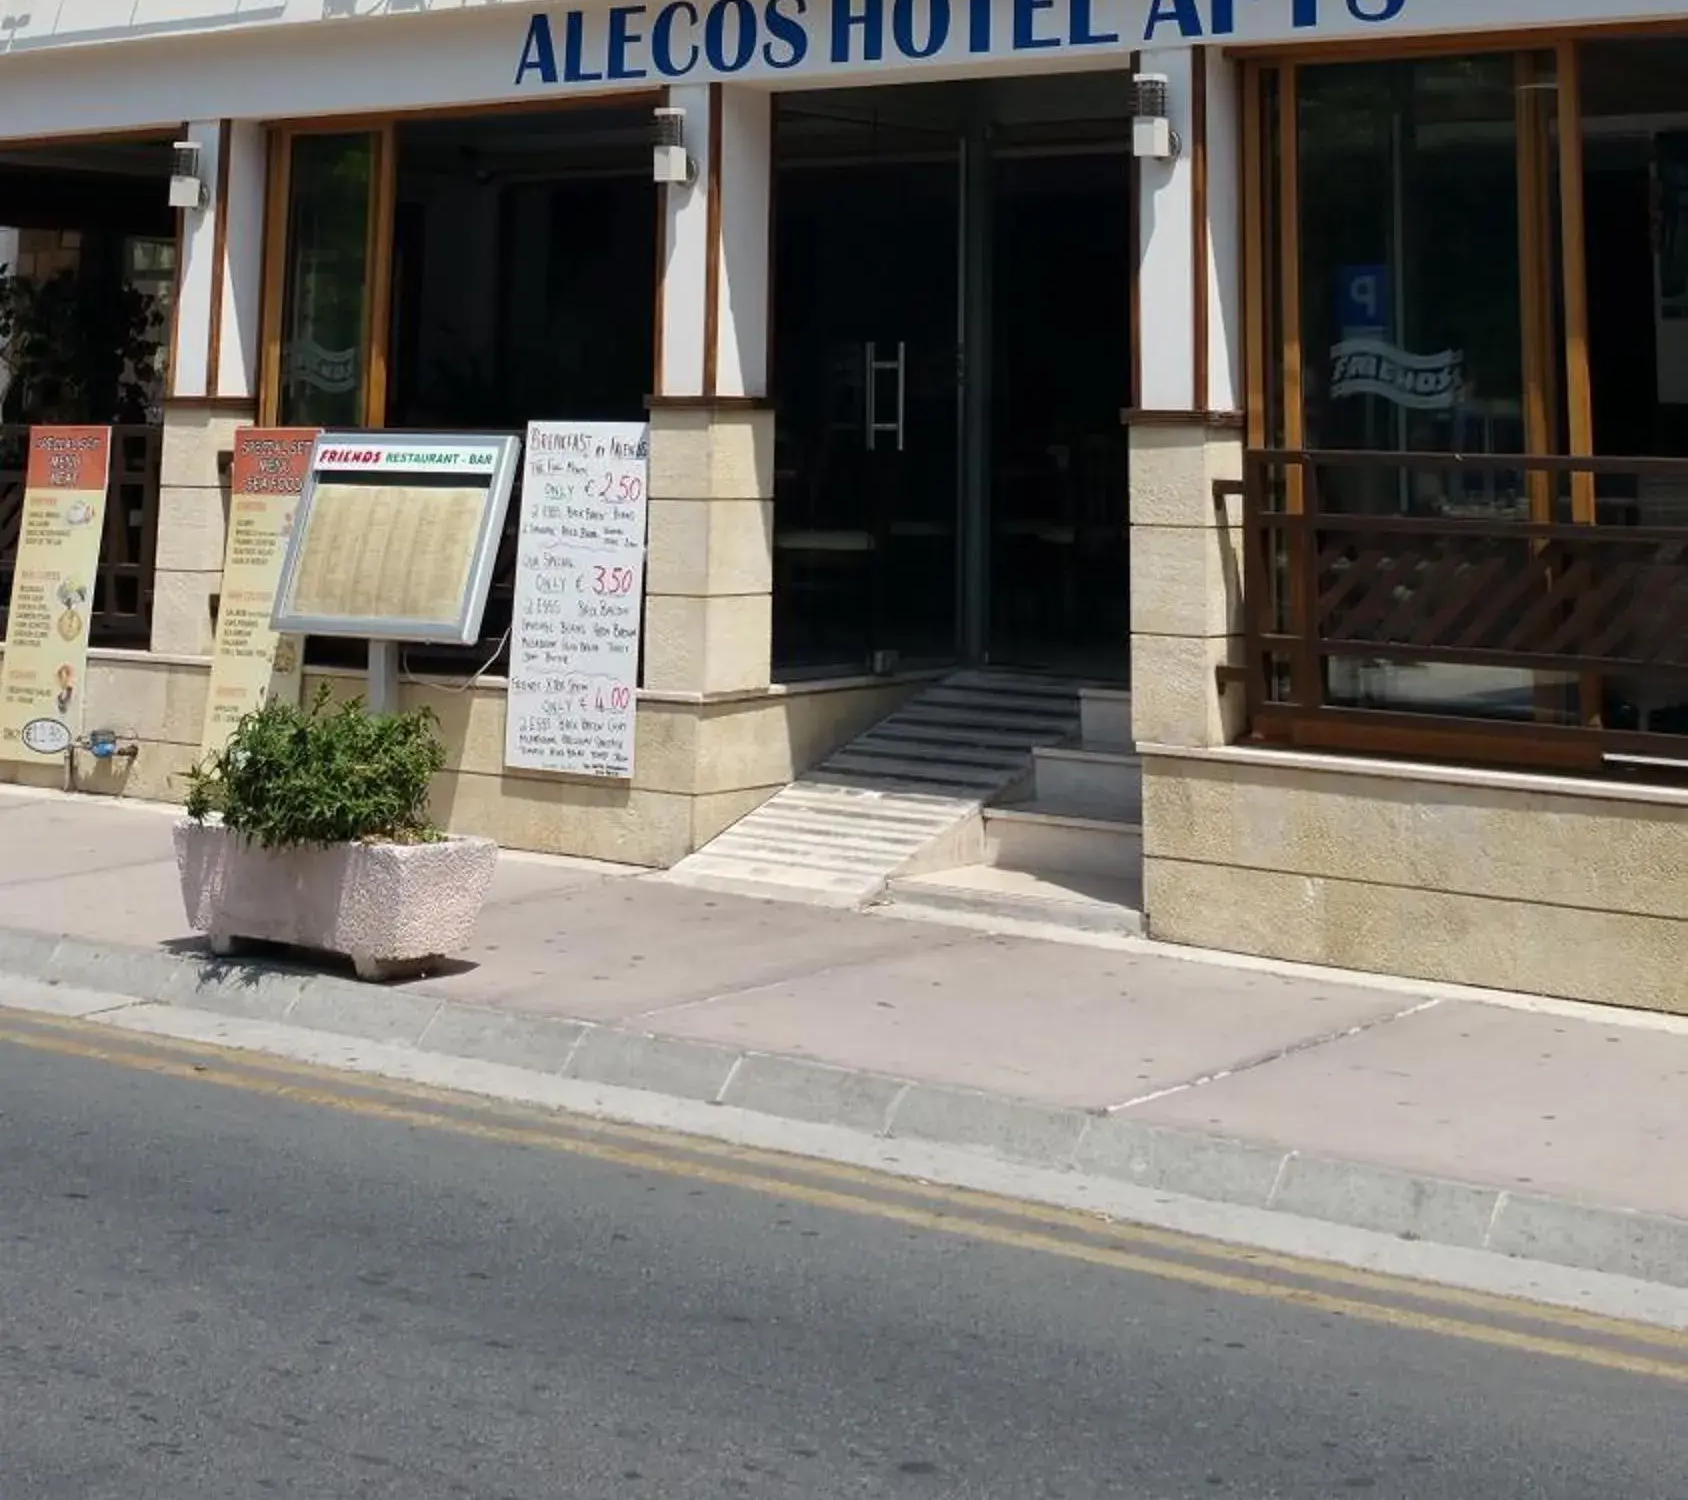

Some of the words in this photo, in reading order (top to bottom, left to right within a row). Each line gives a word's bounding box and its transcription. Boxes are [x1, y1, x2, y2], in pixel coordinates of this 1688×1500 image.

[319, 449, 383, 463] FRIENDS
[385, 451, 459, 465] RESTAURANT
[469, 453, 493, 465] BAR
